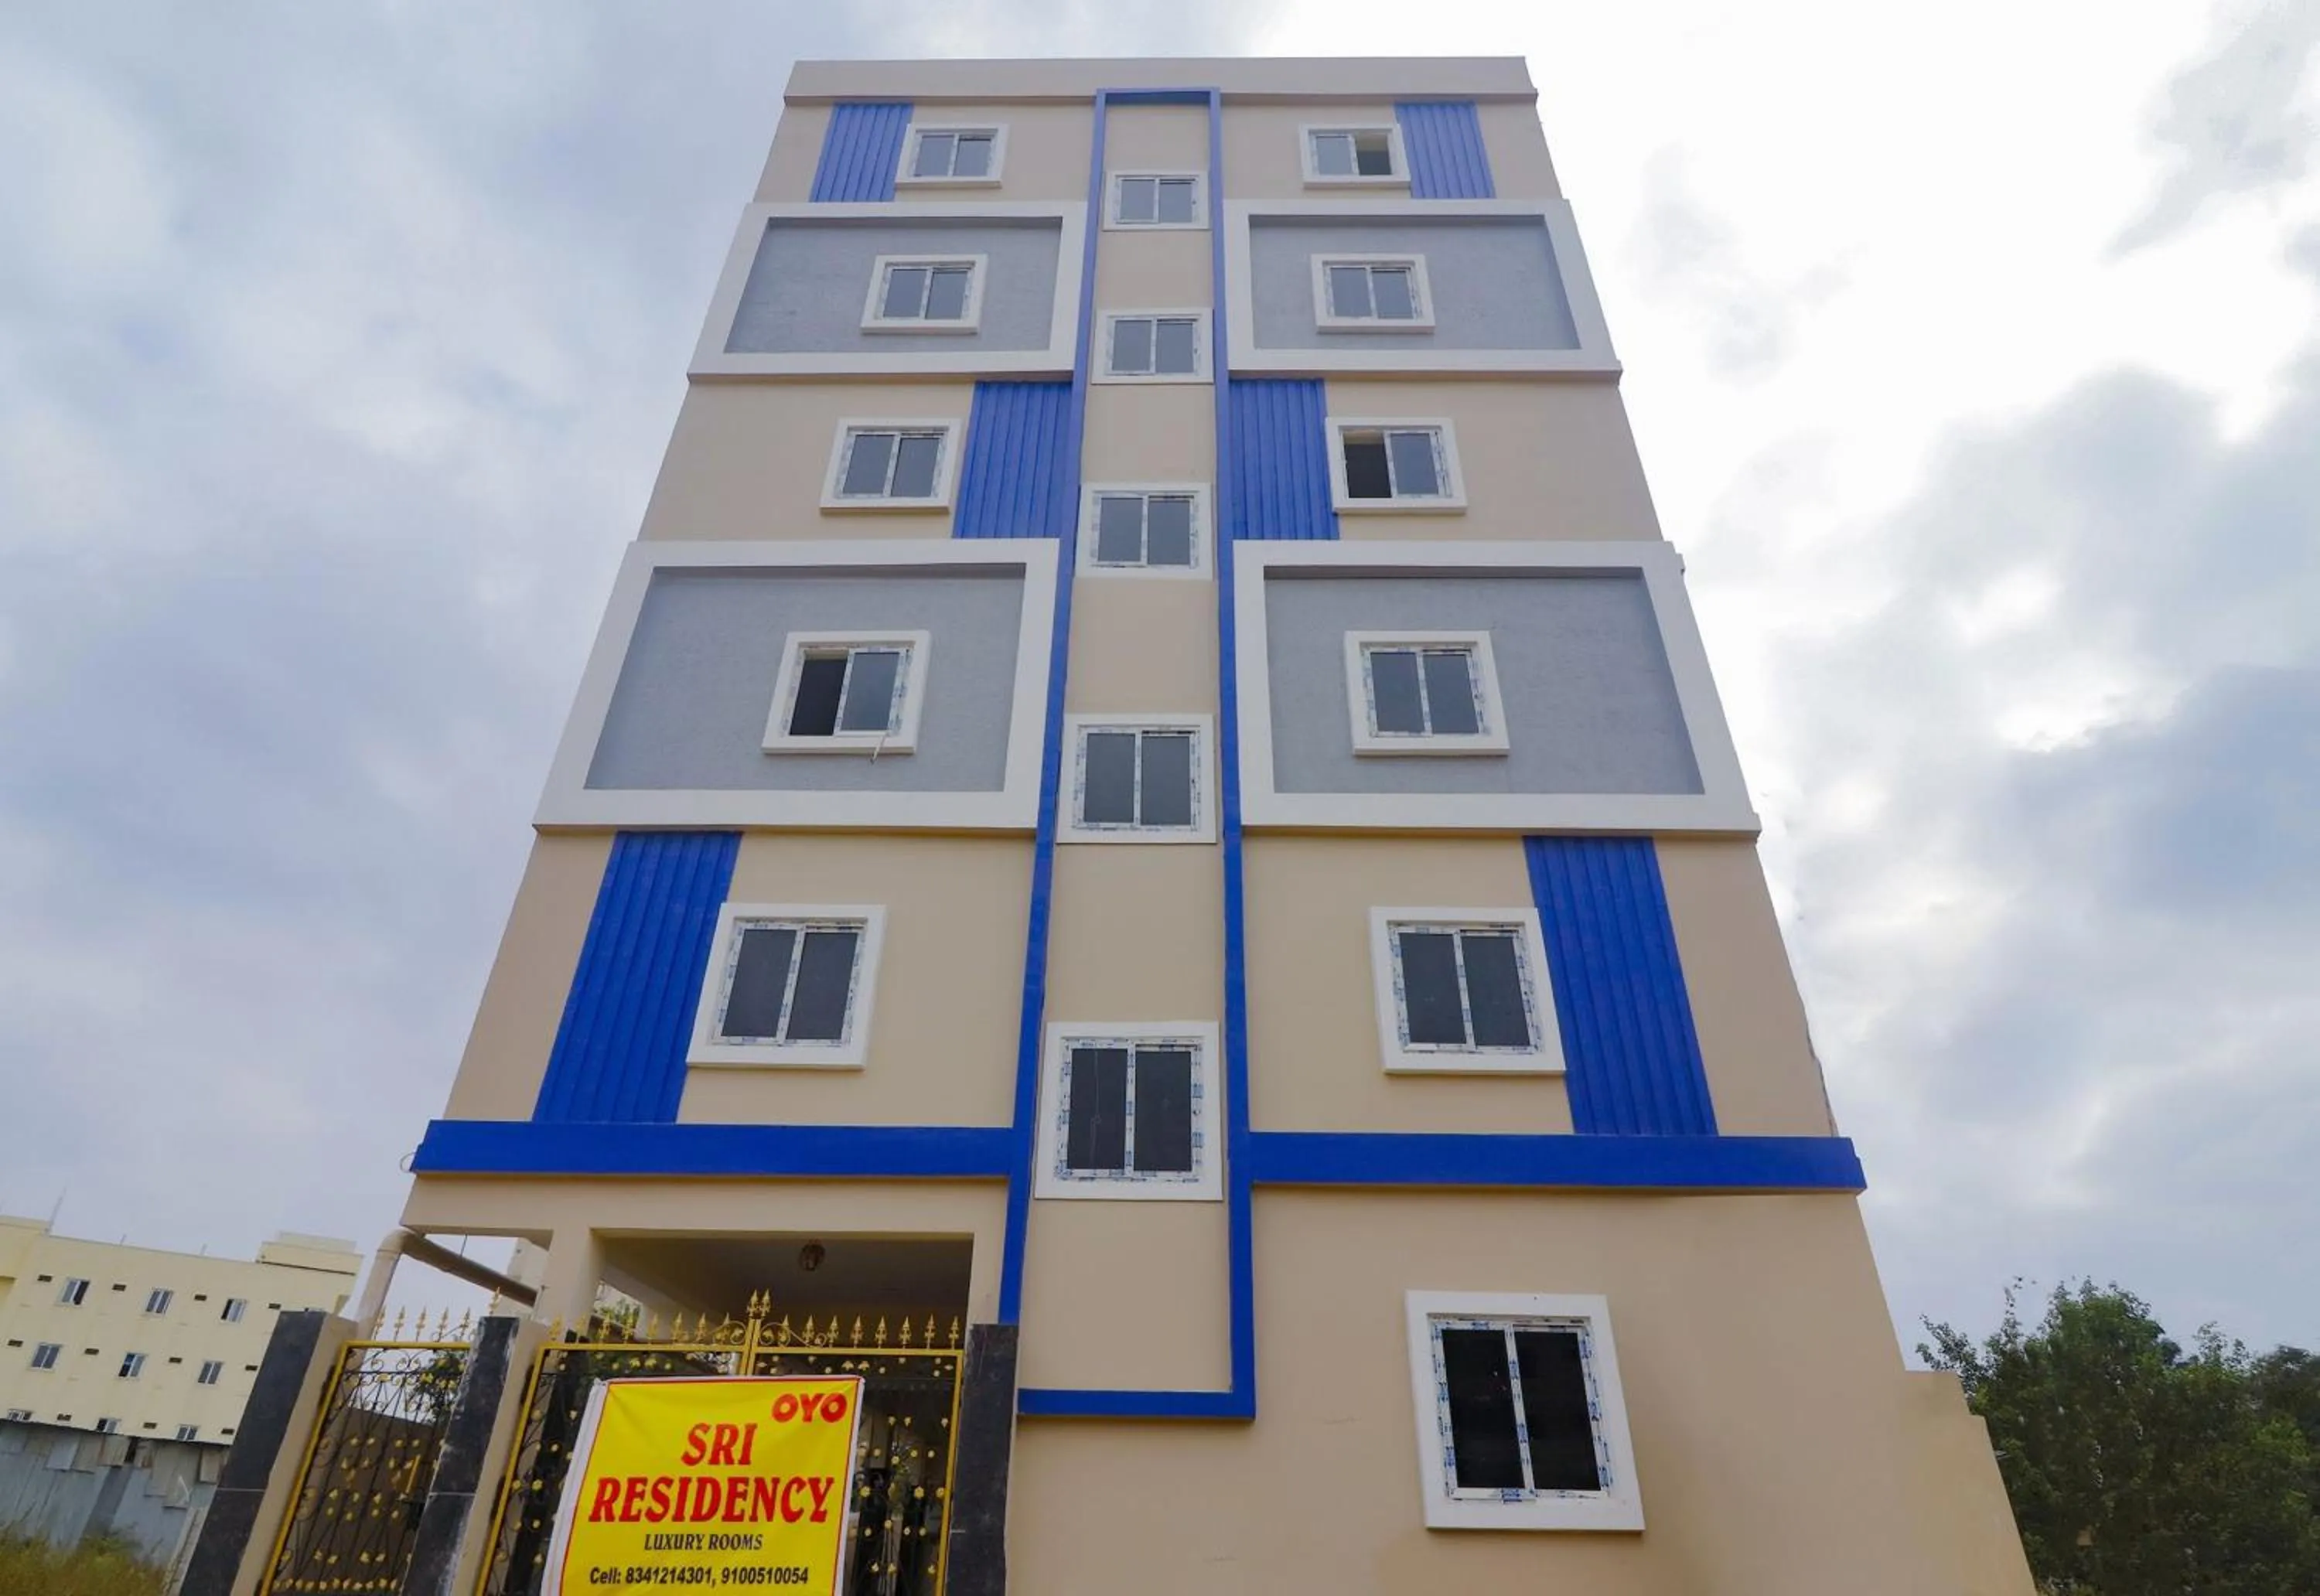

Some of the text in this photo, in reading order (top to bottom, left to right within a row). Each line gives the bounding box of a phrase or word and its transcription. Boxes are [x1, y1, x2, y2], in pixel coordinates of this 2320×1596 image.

[771, 1393, 848, 1423] OYO
[681, 1422, 759, 1466] SRI
[588, 1476, 835, 1523] RESIDENCY
[644, 1533, 763, 1550] LUXURY ROOMS
[589, 1566, 809, 1587] Cell: 8341214301, 9100510054
